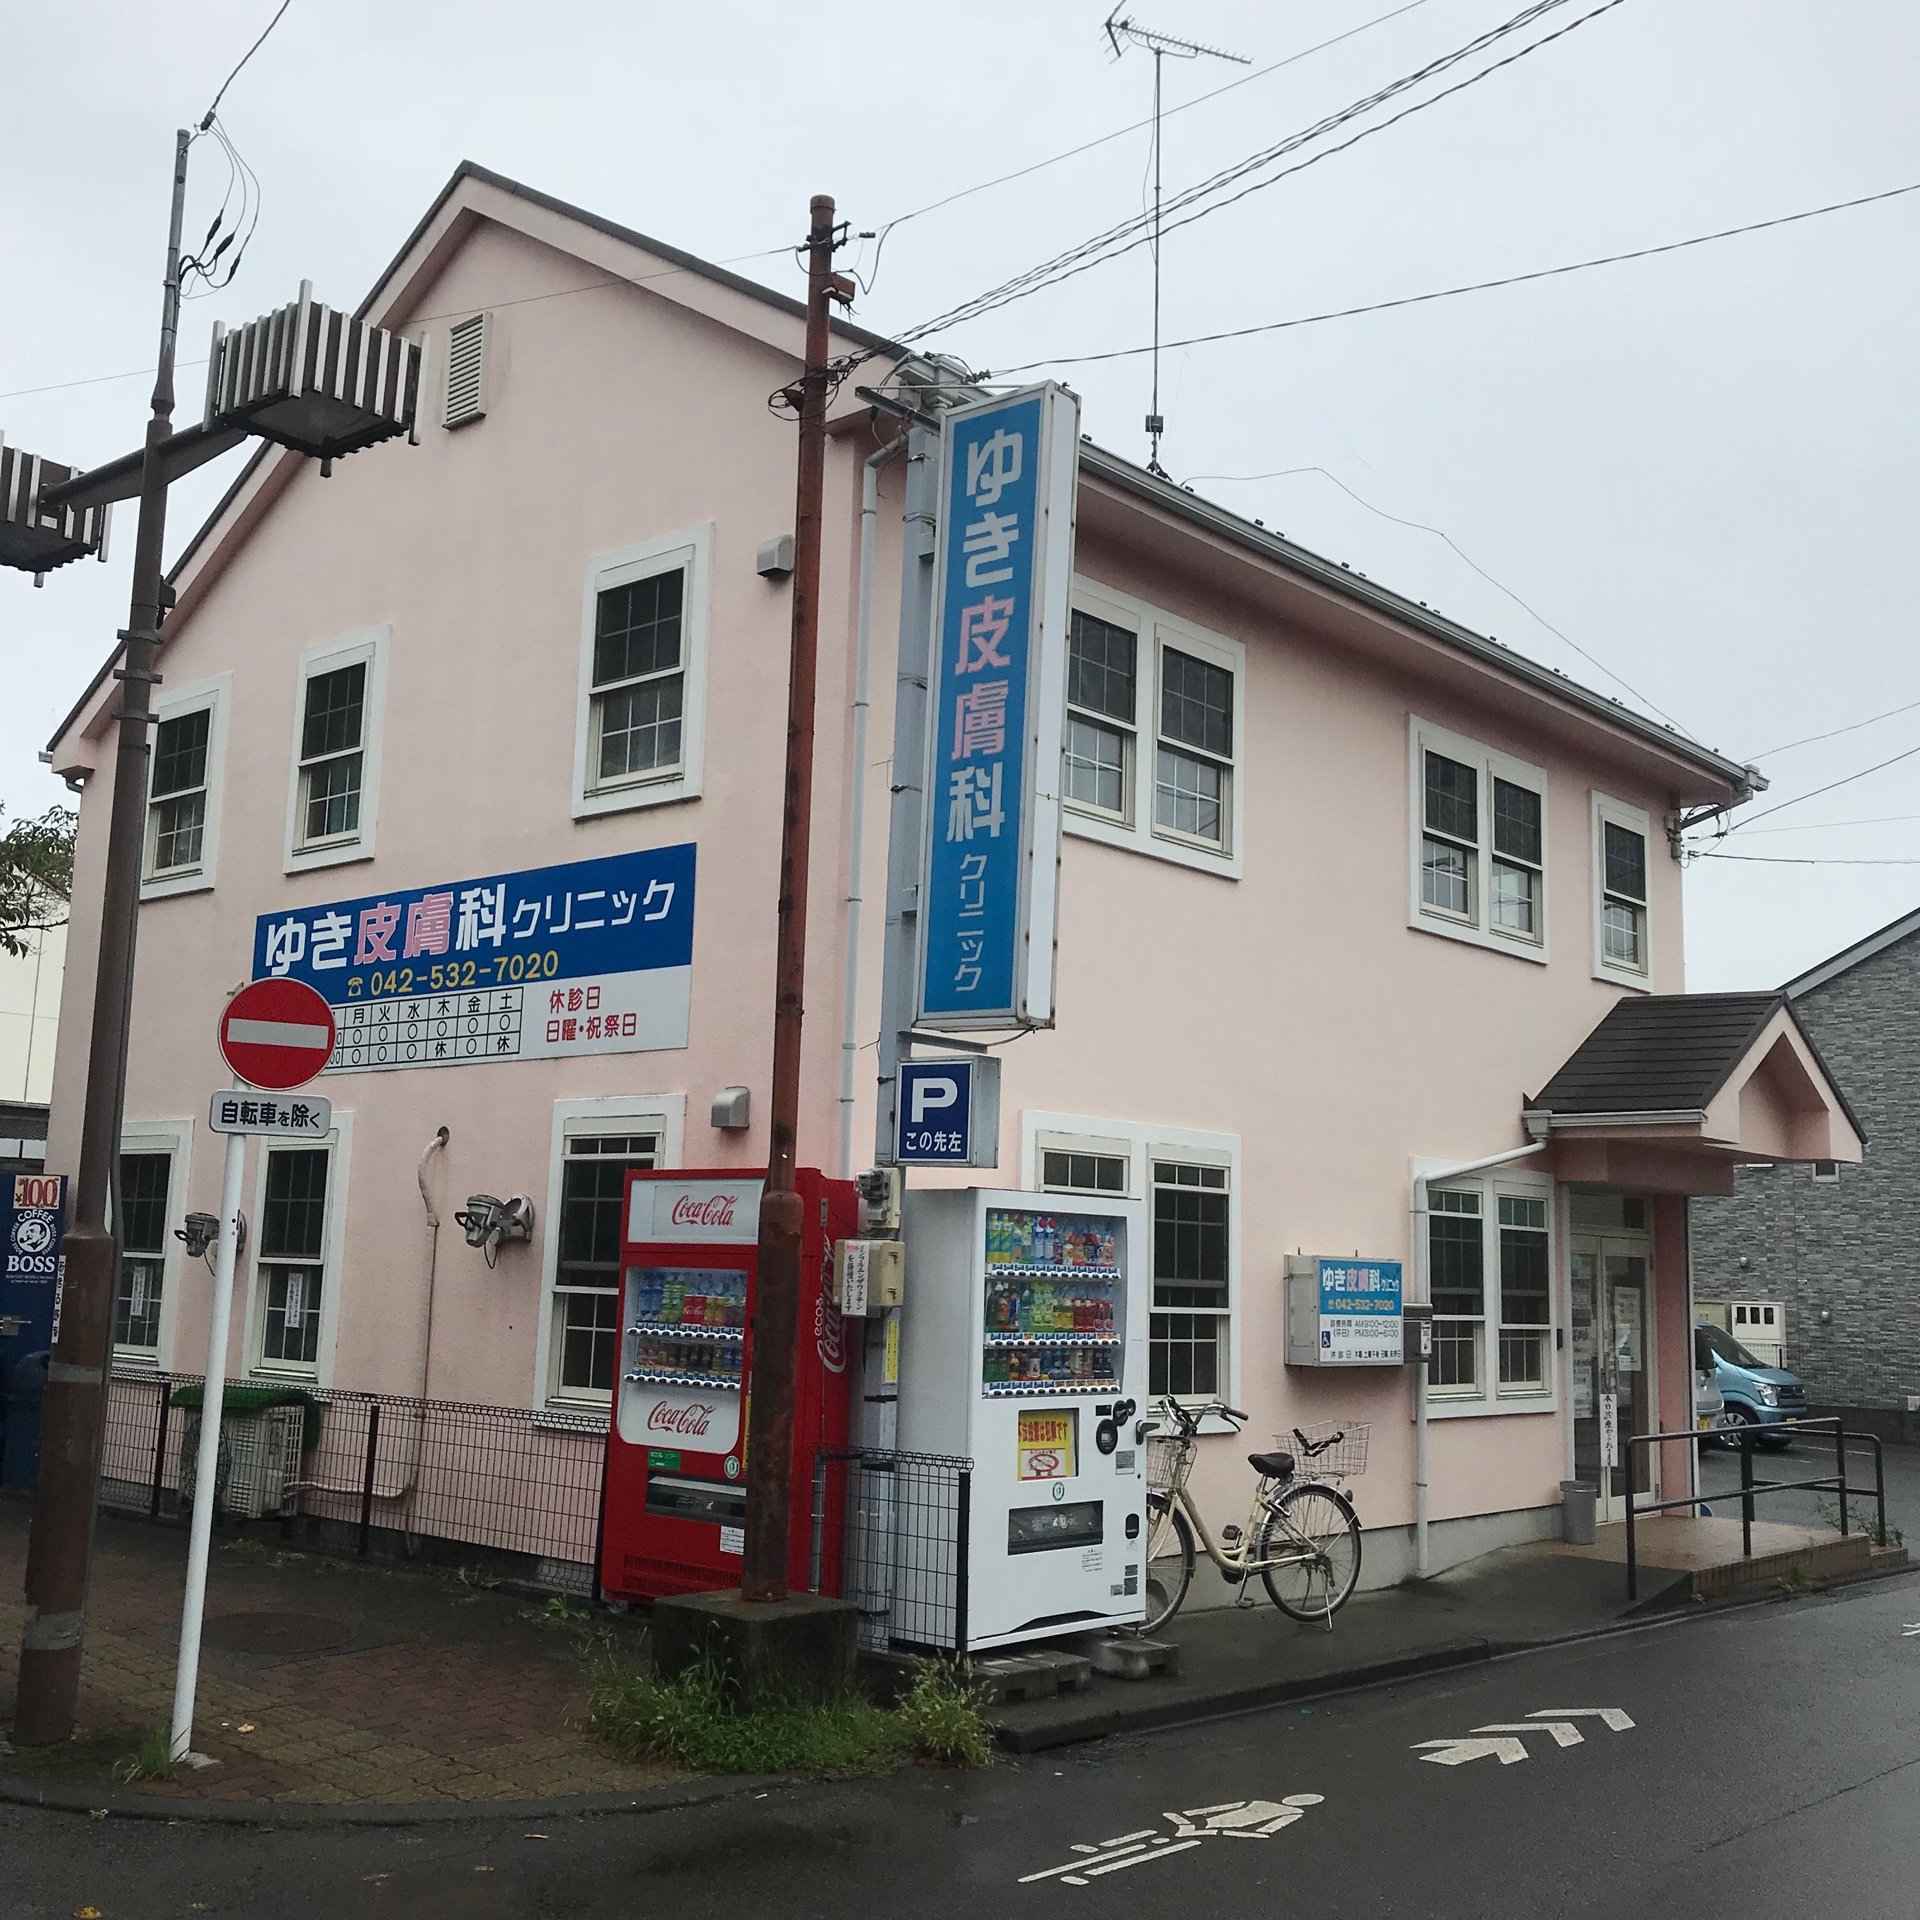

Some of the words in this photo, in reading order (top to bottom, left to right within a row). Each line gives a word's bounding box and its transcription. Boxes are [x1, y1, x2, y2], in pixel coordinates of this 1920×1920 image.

[947, 428, 1023, 992] ゆき皮膚科クリニック
[264, 880, 676, 976] ゆき皮膚科クリニック
[370, 950, 558, 997] 042-532-7020
[352, 1008, 365, 1025] 月
[378, 1006, 390, 1022] 火
[407, 1003, 420, 1019] 水
[437, 1000, 450, 1016] 木
[467, 996, 481, 1013] 金
[499, 993, 513, 1010] 土
[550, 986, 601, 1014] 休診日
[434, 1041, 447, 1057] 休
[496, 1036, 510, 1052] 休
[221, 1100, 320, 1129] 自転車を除く
[911, 1077, 958, 1123] P
[906, 1131, 962, 1152] この先左
[17, 1209, 54, 1224] COFFEE
[6, 1255, 55, 1273] BOSS
